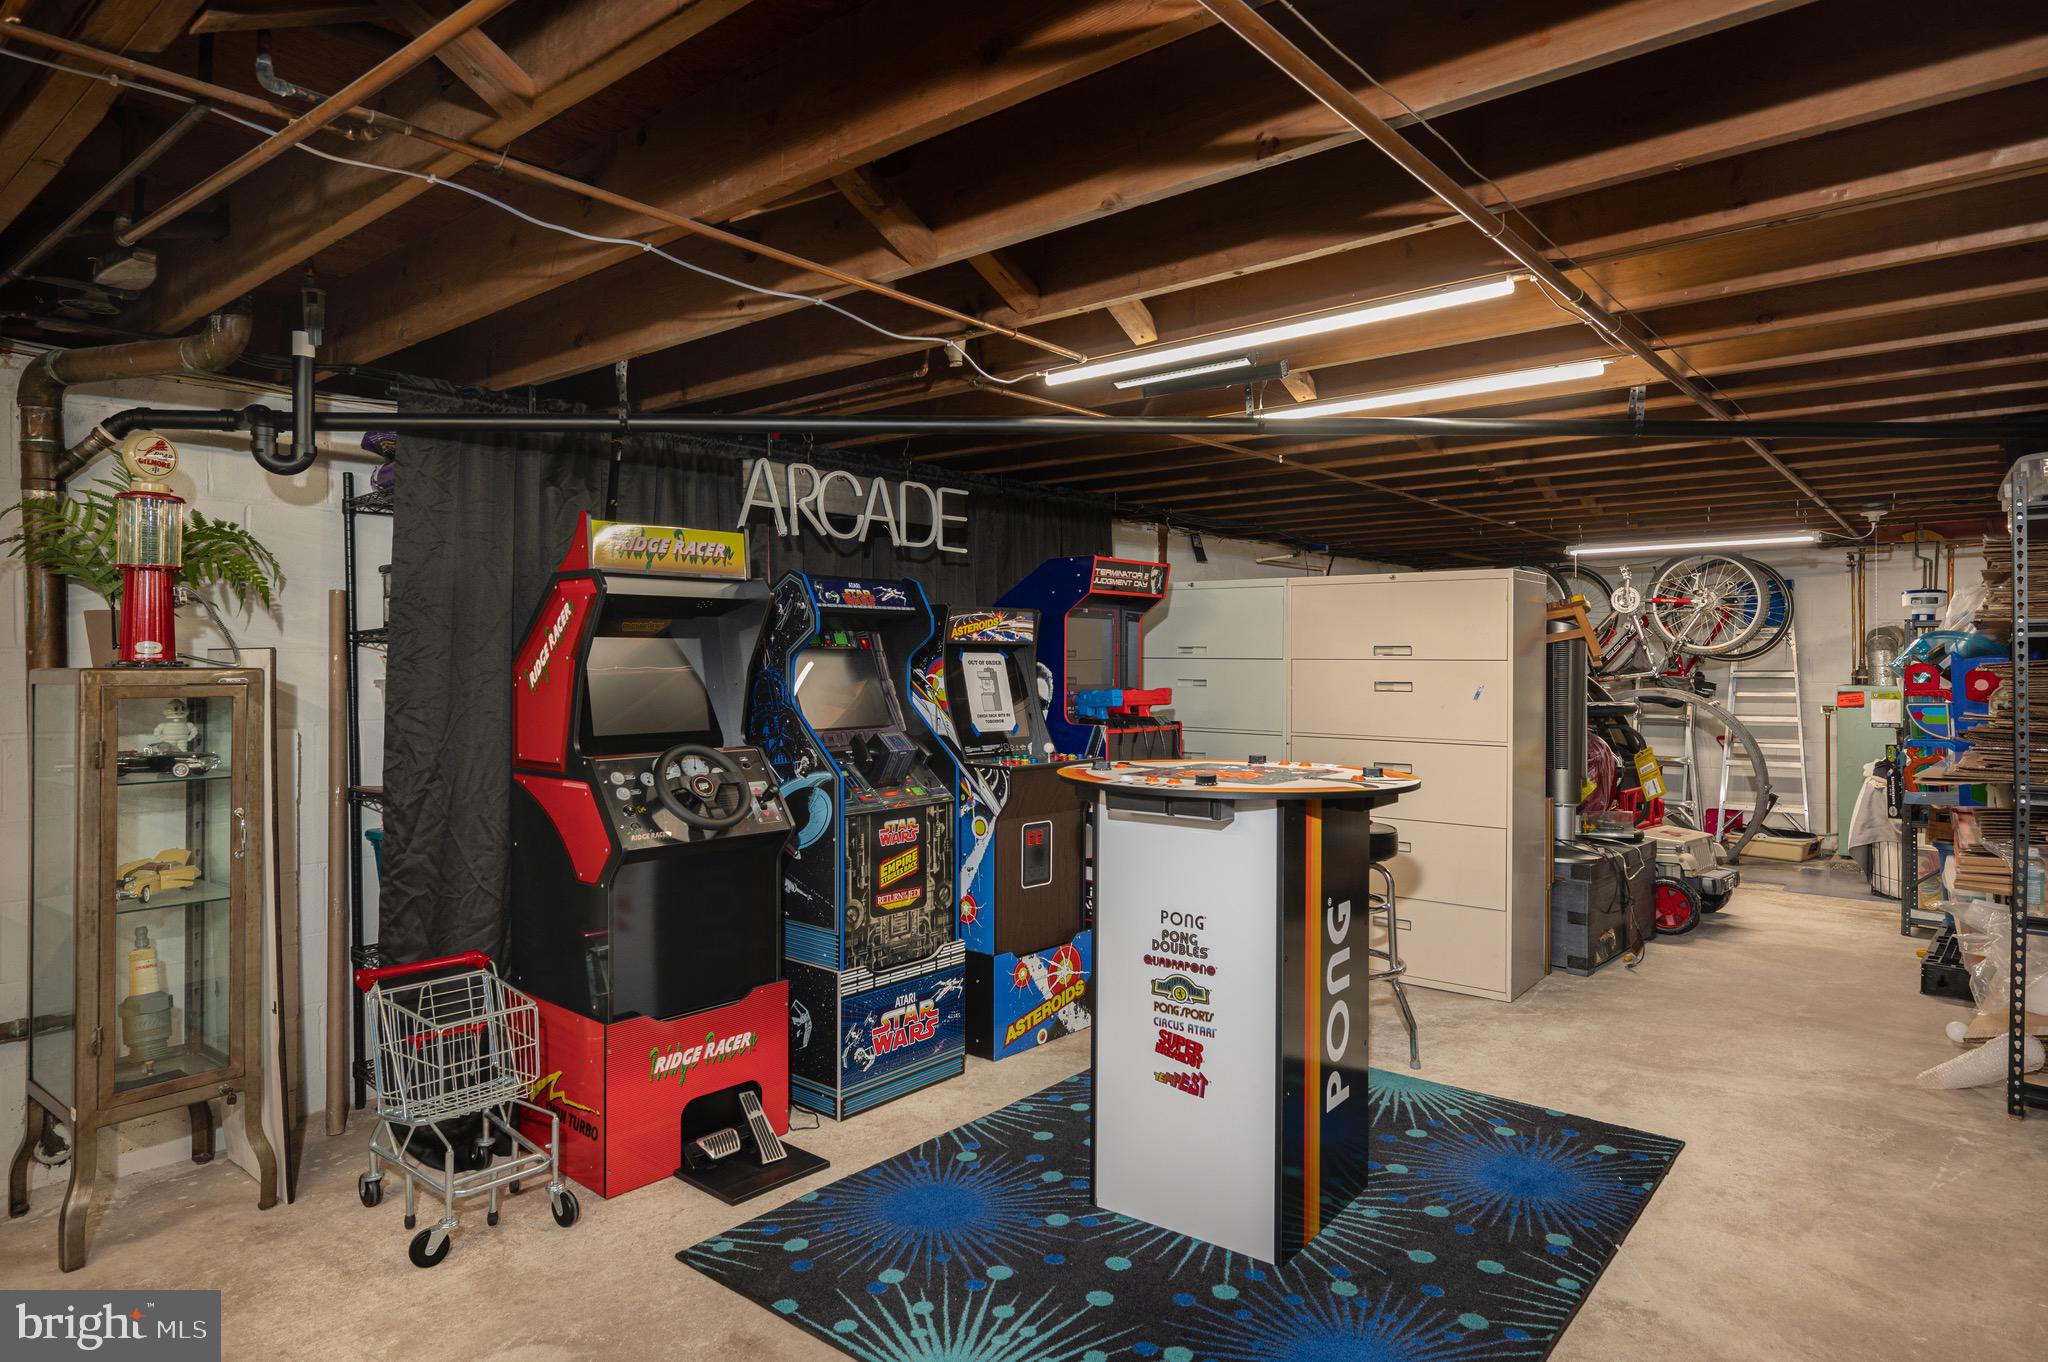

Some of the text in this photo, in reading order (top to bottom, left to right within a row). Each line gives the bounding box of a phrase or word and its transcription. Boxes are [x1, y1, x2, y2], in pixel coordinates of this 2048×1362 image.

[137, 457, 171, 469] GILMORE
[737, 457, 969, 554] ARCADE
[672, 538, 727, 558] RACER
[1094, 576, 1149, 588] JUDGMENT DAY
[1095, 567, 1150, 580] TERMINATOR 2
[951, 617, 1000, 639] ASTEROIDS
[529, 602, 572, 689] RIDGE RACER
[879, 817, 919, 834] STAR
[880, 829, 919, 847] WARS
[880, 850, 918, 878] EMPIRE
[877, 892, 901, 905] RETURN
[1160, 909, 1206, 931] PONG
[1152, 938, 1210, 960] DOUBLES
[1162, 929, 1199, 946] PONG
[1143, 954, 1217, 977] QUADRAPONG
[894, 991, 917, 1009] ATARI
[1153, 1000, 1215, 1023] PONG SPORTS
[1326, 899, 1352, 1114] PONG
[871, 998, 939, 1037] STAR
[1003, 978, 1087, 1049] ASTEROIDS
[871, 1016, 939, 1057] WARS
[1153, 1016, 1216, 1039] CIRCUS ATARI
[1158, 1028, 1205, 1054] SUPER
[653, 1031, 752, 1075] RIDGE RACER
[1154, 1041, 1205, 1069] BREAKOUT
[1153, 1071, 1210, 1099] TEMPEST
[568, 1112, 599, 1142] TURBO
